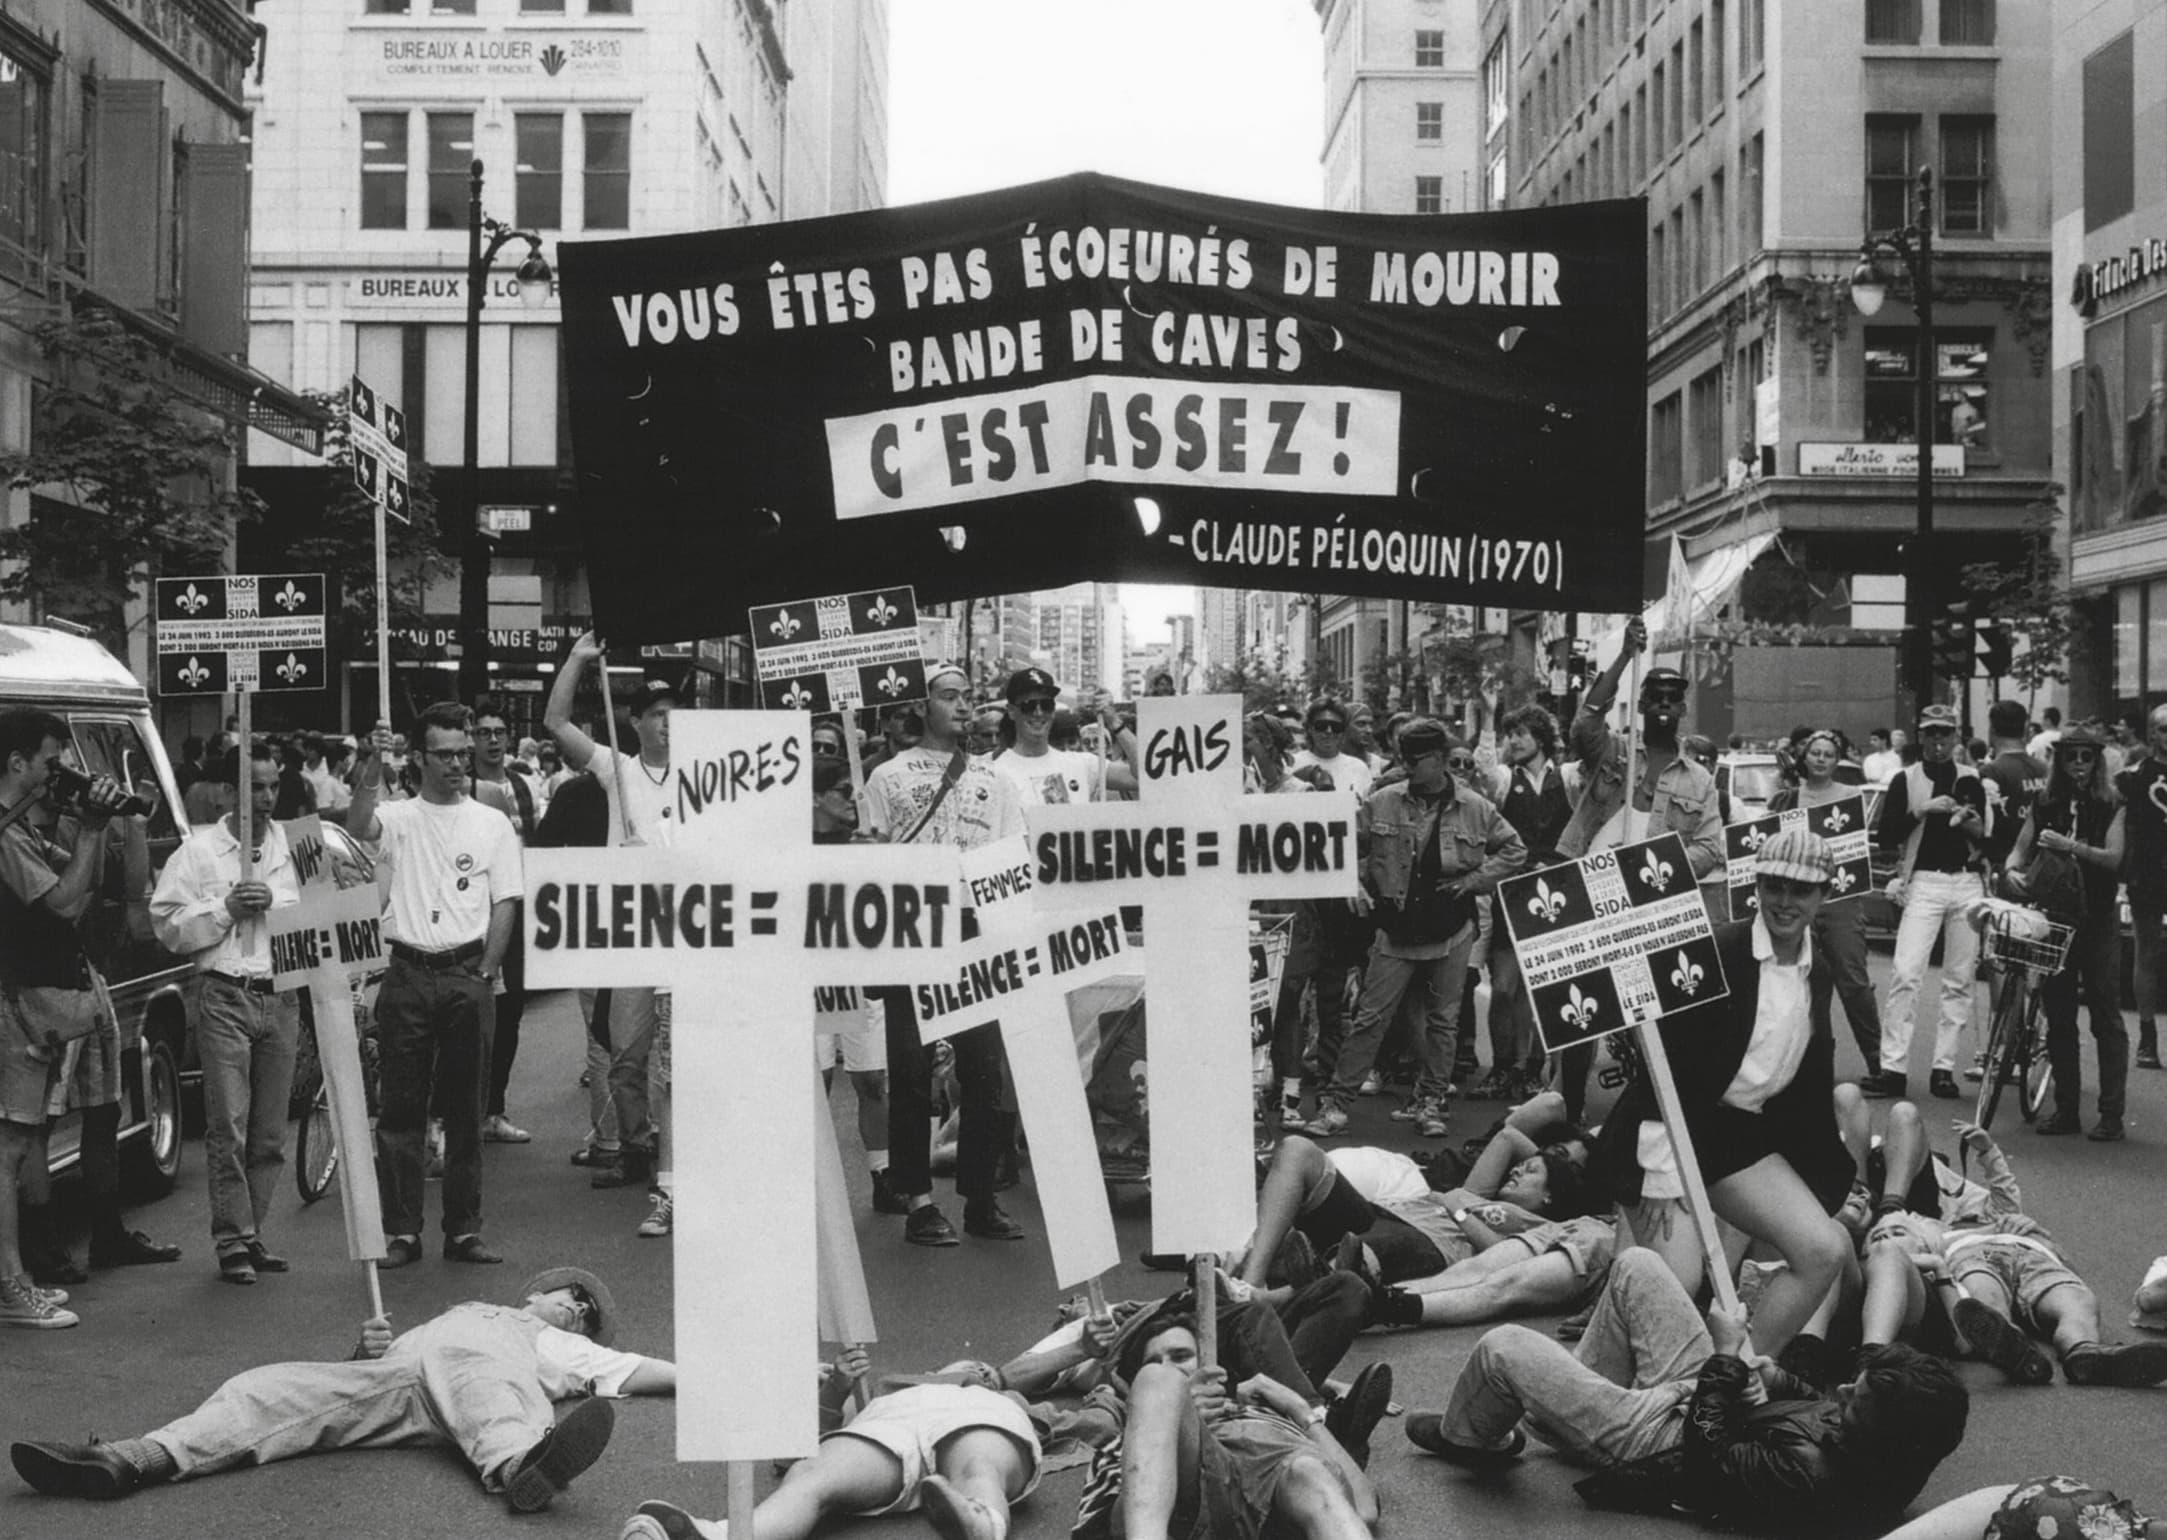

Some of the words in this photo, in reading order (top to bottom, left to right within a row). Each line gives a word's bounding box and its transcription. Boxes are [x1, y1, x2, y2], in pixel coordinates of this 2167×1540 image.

[384, 41, 458, 60] BUREAUX
[480, 41, 532, 60] LOUER
[361, 279, 459, 297] BUREAUX
[611, 282, 741, 348] VOUS
[767, 260, 876, 331] ÊTES
[901, 247, 992, 310] PAS
[1020, 223, 1254, 292] ÉCOEURÉS
[1283, 245, 1337, 299] DE
[1369, 249, 1561, 307] MOURIR
[888, 318, 1044, 394] BANDE
[1071, 308, 1124, 364] DE
[1151, 315, 1302, 373] CAVES
[869, 399, 1051, 501] C'EST
[1311, 514, 1461, 580] PÉLOQUIN
[1467, 532, 1563, 592] (1970)
[228, 577, 256, 588] NOS
[818, 597, 846, 609] NOS
[227, 608, 258, 620] SIDA
[820, 626, 852, 640] SIDA
[1144, 719, 1231, 780] GAIS
[1781, 810, 1806, 822] NOS
[1036, 826, 1187, 884] SILENCE
[1196, 830, 1219, 867] =
[1236, 820, 1348, 875] MORT
[1581, 851, 1616, 875] NOS
[970, 861, 1033, 909] FEMMES
[1594, 895, 1632, 919] SIDA
[533, 882, 735, 950] SILENCE
[750, 890, 779, 936] =
[803, 882, 950, 949] MORT
[1523, 957, 1534, 970] LE
[1534, 954, 1546, 966] 24
[1564, 942, 1586, 958] 1992
[1657, 914, 1682, 930] AURONT
[1688, 907, 1704, 920] SIDA
[270, 928, 320, 975] SILENCE
[335, 918, 382, 964] MORT
[918, 949, 1024, 1022] SILENCE
[1047, 913, 1122, 976] MORT
[1528, 971, 1550, 986] DONT
[1574, 955, 1602, 973] SERONT
[1642, 937, 1660, 951] NOUS
[1623, 997, 1634, 1010] LE
[1636, 991, 1657, 1007] SIDA
